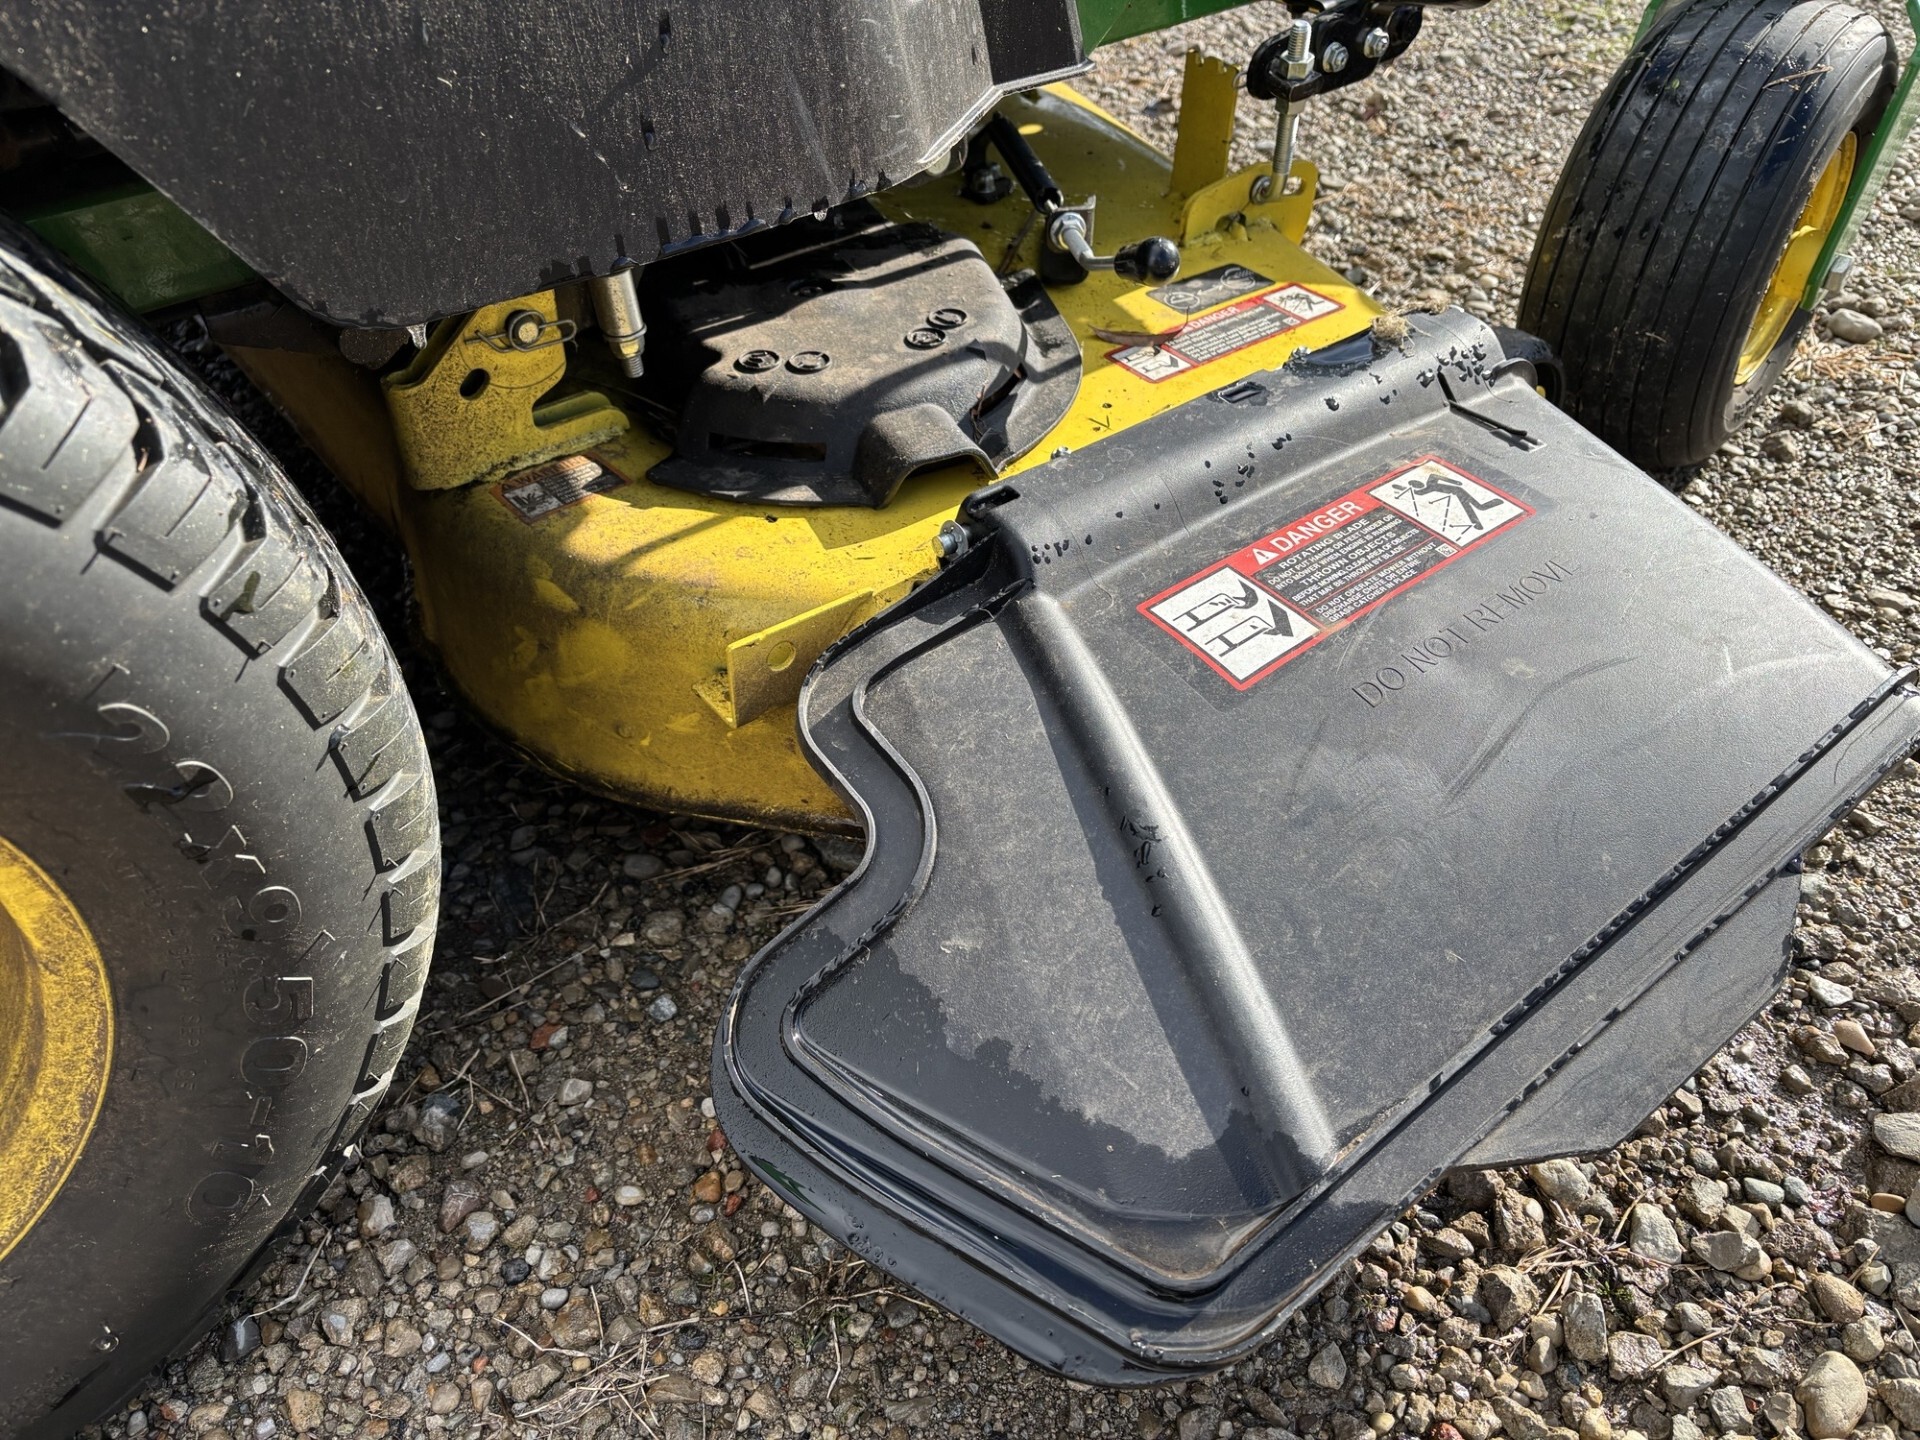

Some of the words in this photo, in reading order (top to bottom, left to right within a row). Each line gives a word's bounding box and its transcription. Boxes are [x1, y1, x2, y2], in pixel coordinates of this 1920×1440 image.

[1191, 306, 1240, 332] DANGER
[1267, 576, 1282, 585] DO
[1278, 568, 1297, 579] NOT
[1293, 560, 1311, 570] PUT
[1308, 547, 1335, 562] HANDS
[1331, 541, 1345, 549] OR
[1342, 532, 1362, 543] FEET
[1358, 519, 1385, 534] UNDER
[1381, 513, 1395, 521] OR
[1269, 500, 1364, 551] DANGER
[1278, 537, 1335, 569] ROTATING
[1331, 518, 1370, 539] BLADE
[1273, 577, 1294, 590] INTO
[1291, 563, 1321, 580] MOWER
[1318, 551, 1342, 565] WHEN
[1338, 537, 1366, 554] ENGINE
[1291, 583, 1321, 601] BEFORE
[1344, 556, 1368, 571] CLEAR
[1364, 547, 1384, 559] AREA
[1380, 542, 1393, 550] OF
[1389, 527, 1419, 545] OBJECTS
[1299, 557, 1349, 586] THROWN
[1346, 530, 1397, 559] OBJECTS
[1299, 593, 1320, 606] THAT
[1317, 585, 1335, 595] MAY
[1332, 579, 1345, 587] BE
[1341, 562, 1374, 581] THROWN
[1380, 544, 1405, 559] BLADE
[1315, 604, 1330, 613] DO
[1327, 594, 1346, 606] NOT
[1343, 575, 1379, 597] OPERATE
[1376, 559, 1406, 577] MOWER
[1403, 541, 1437, 561] WITHOUT
[1321, 592, 1364, 618] DISCHARGE
[1361, 578, 1386, 594] CHUTE
[1383, 572, 1397, 580] OR
[1394, 558, 1421, 574] ENTIRE
[1327, 604, 1356, 622] GRASS
[1352, 586, 1387, 607] CATCHER
[1391, 568, 1417, 583] PLACE
[1352, 667, 1405, 708] DO
[1401, 625, 1468, 673] NOT
[1463, 557, 1580, 632] REMOVE
